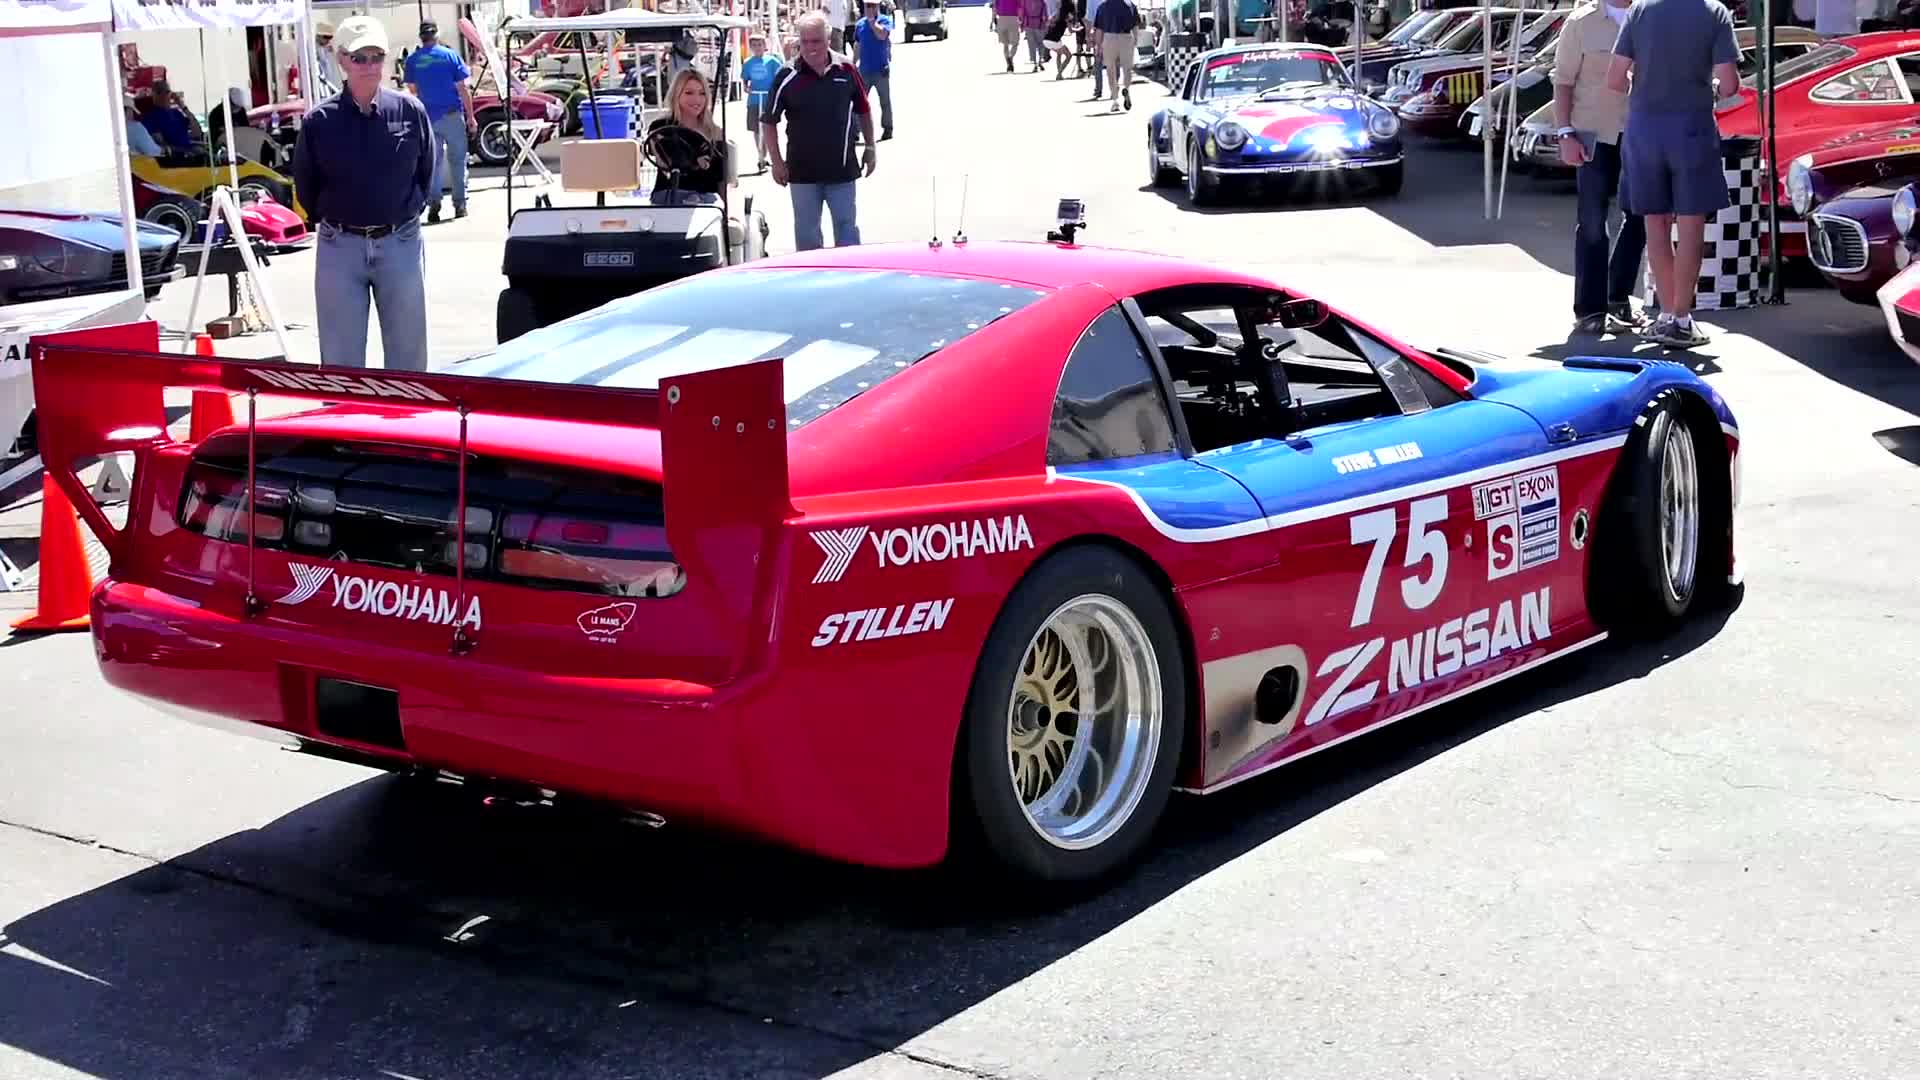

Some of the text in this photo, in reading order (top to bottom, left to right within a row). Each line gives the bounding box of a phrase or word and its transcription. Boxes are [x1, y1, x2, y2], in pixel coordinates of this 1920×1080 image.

[246, 368, 450, 402] NISSAN
[1489, 485, 1512, 506] GT
[1518, 474, 1555, 500] EXXON
[871, 514, 1034, 568] YOKOHAMA
[1350, 496, 1449, 628] 75
[1492, 524, 1513, 569] S
[332, 573, 483, 630] YOKOHAMA
[591, 615, 620, 626] LE MANS
[813, 598, 953, 647] STILLEN
[1388, 587, 1552, 694] NISSAN
